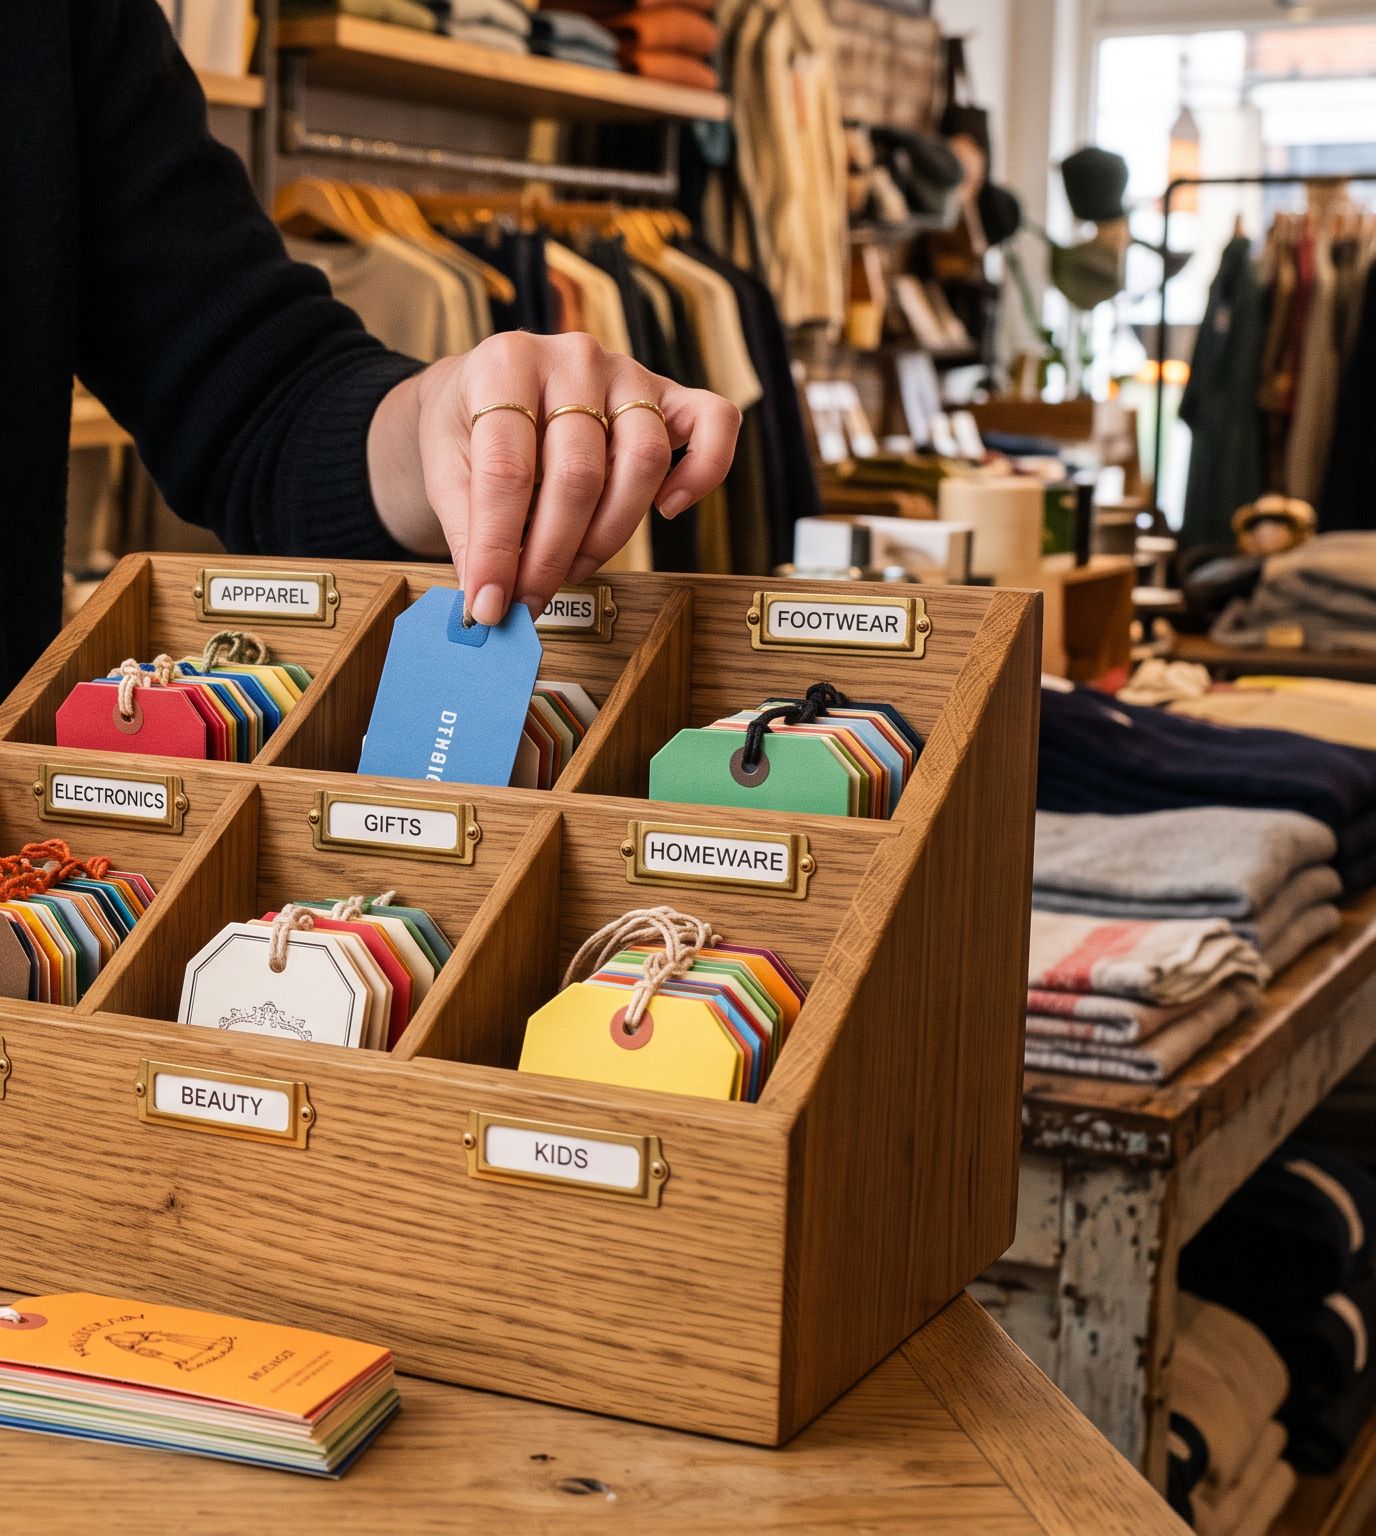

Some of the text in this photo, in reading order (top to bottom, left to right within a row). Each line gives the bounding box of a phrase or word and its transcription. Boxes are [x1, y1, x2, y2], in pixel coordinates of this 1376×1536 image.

[221, 585, 310, 605] APPPAREL
[778, 610, 899, 634] FOOTWEAR
[55, 782, 165, 810] ELECTRONICS
[364, 814, 422, 837] GIFTS
[650, 841, 784, 872] HOMEWARE
[181, 1085, 263, 1116] BEAUTY
[535, 1142, 588, 1169] KIDS
